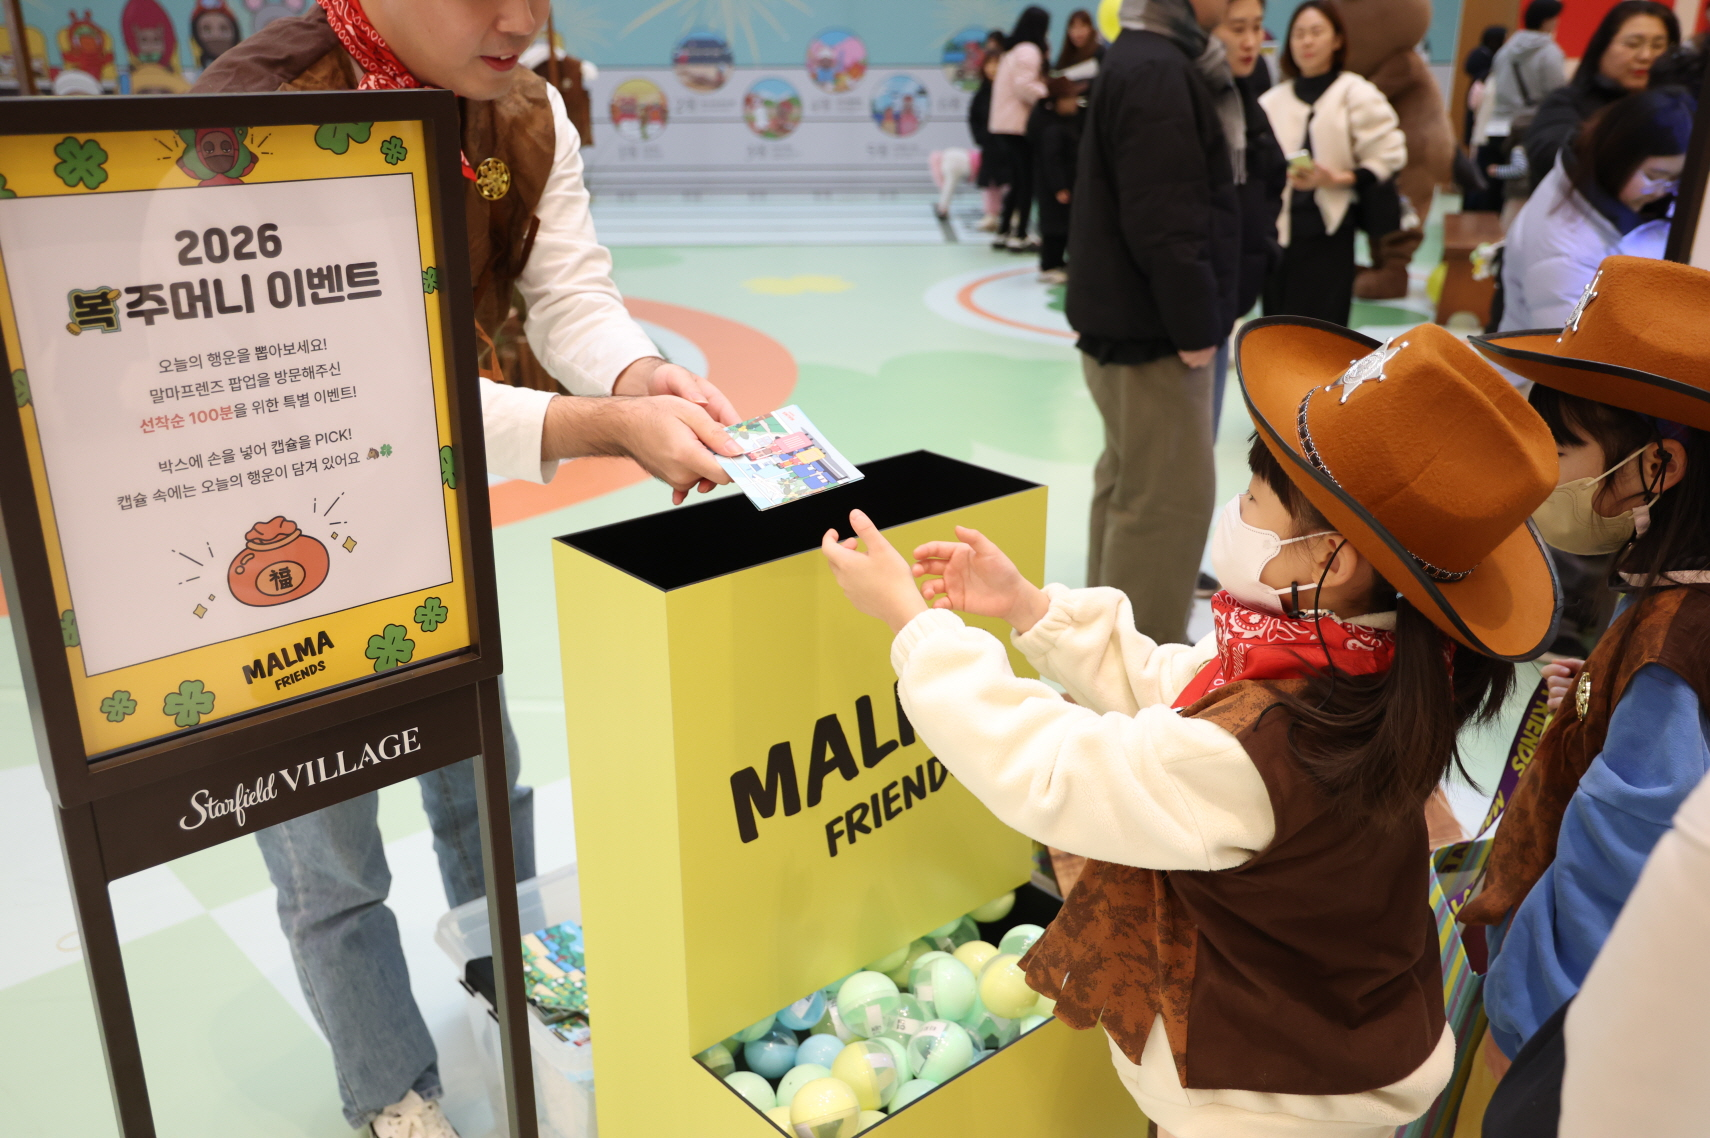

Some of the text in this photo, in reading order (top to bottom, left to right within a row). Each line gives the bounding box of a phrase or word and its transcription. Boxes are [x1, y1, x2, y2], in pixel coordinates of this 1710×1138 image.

[175, 223, 282, 266] 2026
[68, 261, 382, 332] 복주머니 이벤트
[158, 338, 327, 373] 오늘의 행운을 뽑아보세요!
[149, 361, 341, 404] 말마프렌즈 팝업을 방문해주신
[140, 385, 357, 434] 선착순 100분을 위한 특별 이벤트!
[158, 428, 353, 474] 박스에 손을 넣어 캡슐을 PICK!
[117, 452, 360, 510] 캡슐 속에는 오늘의 행운이 담겨 있어요
[269, 566, 293, 591] 福
[242, 630, 335, 685] MALMA
[275, 660, 326, 691] FRIENDS
[179, 726, 421, 830] Starfield VILLAGE
[730, 679, 916, 844] MAL
[825, 755, 954, 857] FRIEND
